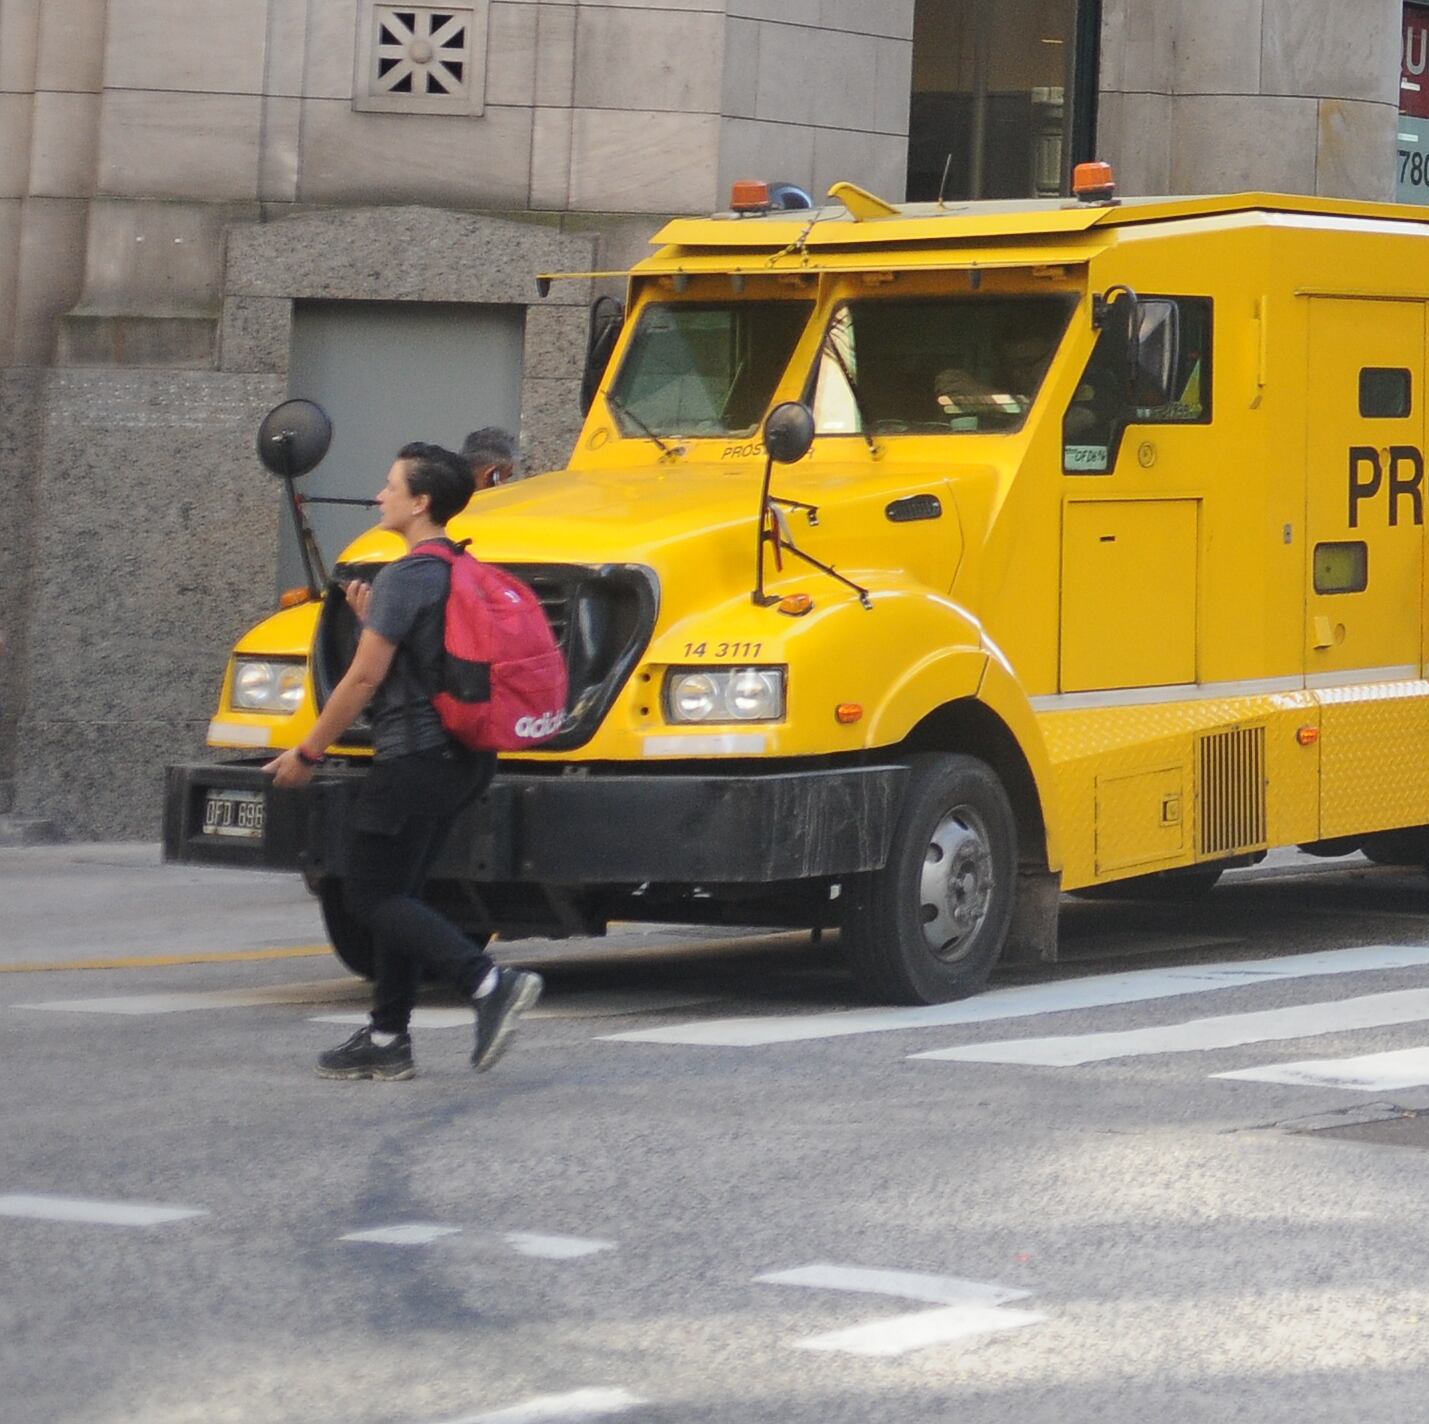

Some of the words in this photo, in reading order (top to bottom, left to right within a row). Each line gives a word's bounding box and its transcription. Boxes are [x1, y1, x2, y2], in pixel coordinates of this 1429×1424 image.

[721, 442, 815, 460] PROSR
[684, 641, 707, 658] 14
[714, 642, 762, 658] 3111
[515, 710, 566, 738] adid
